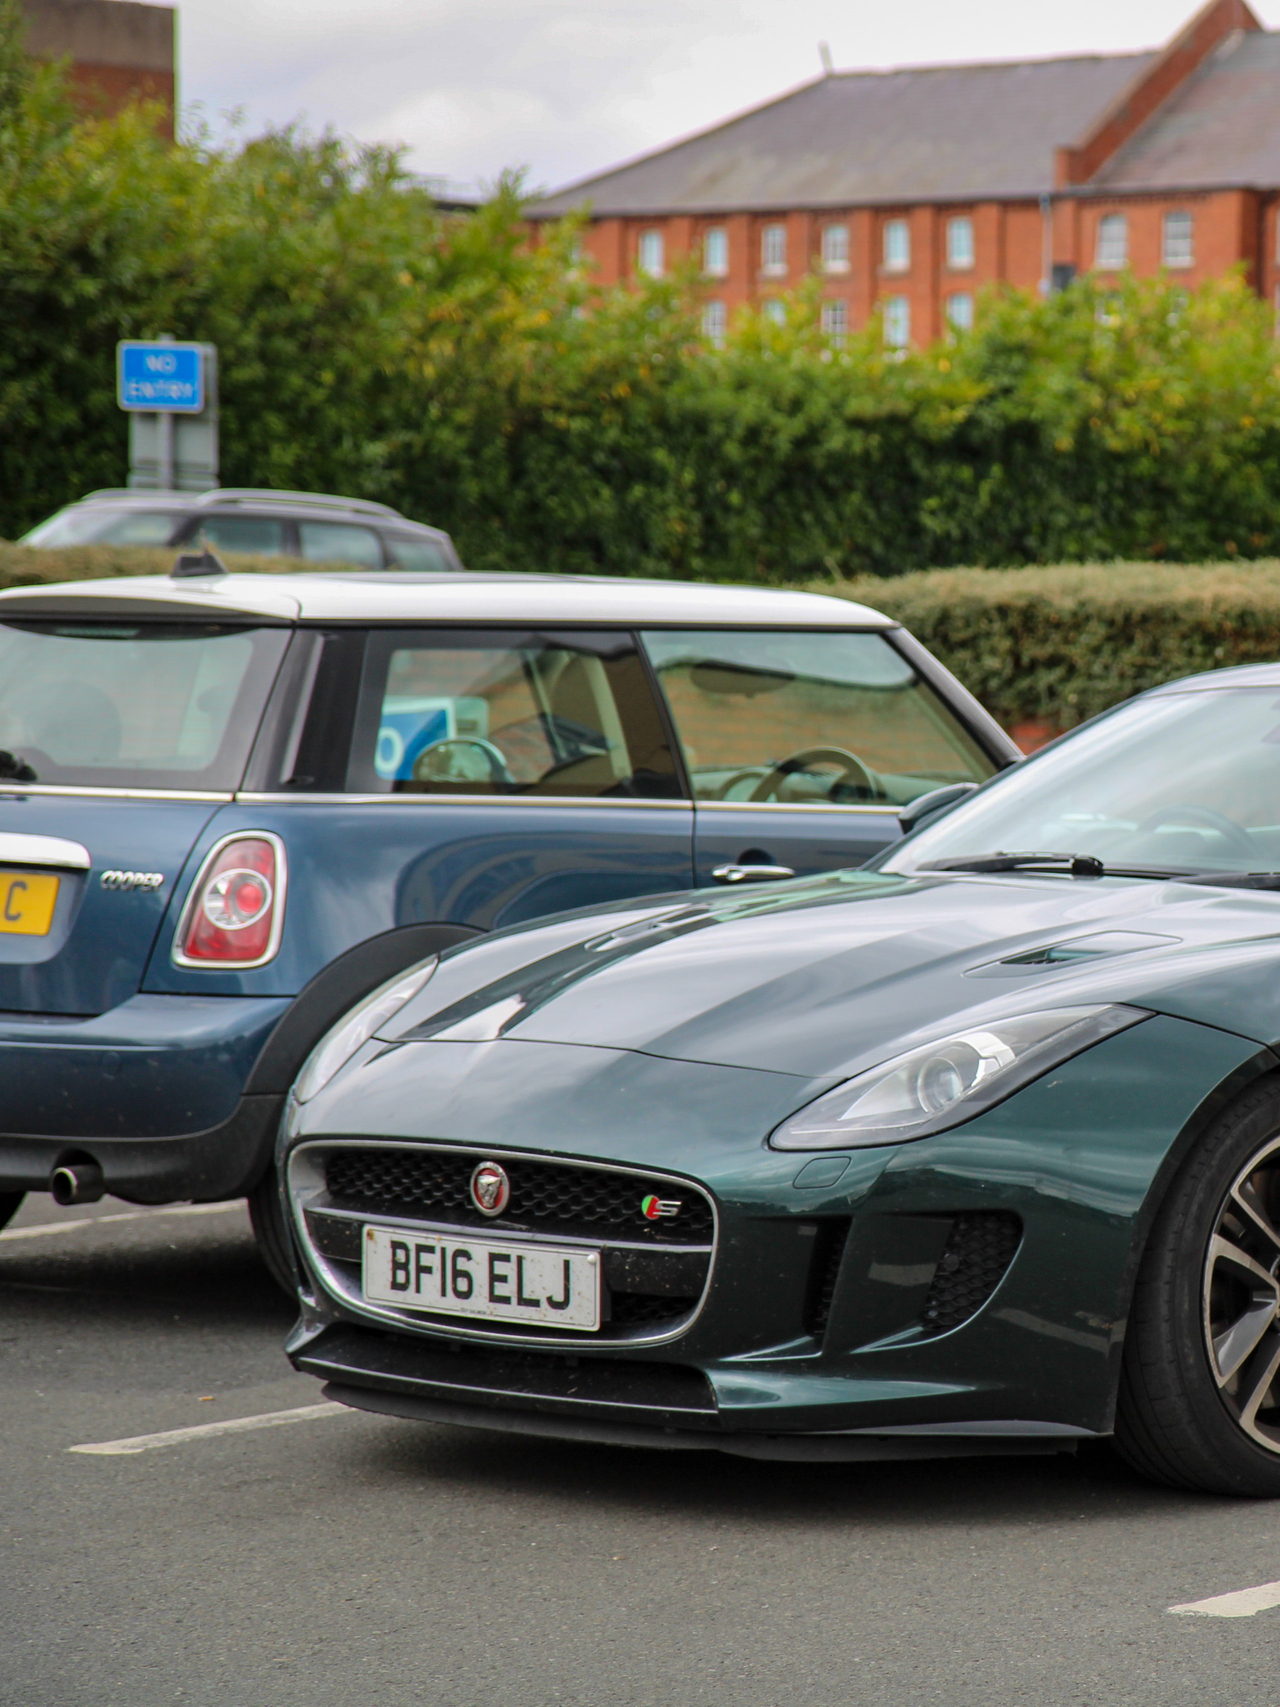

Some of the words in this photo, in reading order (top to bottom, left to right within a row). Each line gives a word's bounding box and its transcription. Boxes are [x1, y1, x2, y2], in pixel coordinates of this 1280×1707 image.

[100, 869, 165, 892] COOPER
[390, 1240, 474, 1300] BF16
[488, 1252, 572, 1311] ELJ
